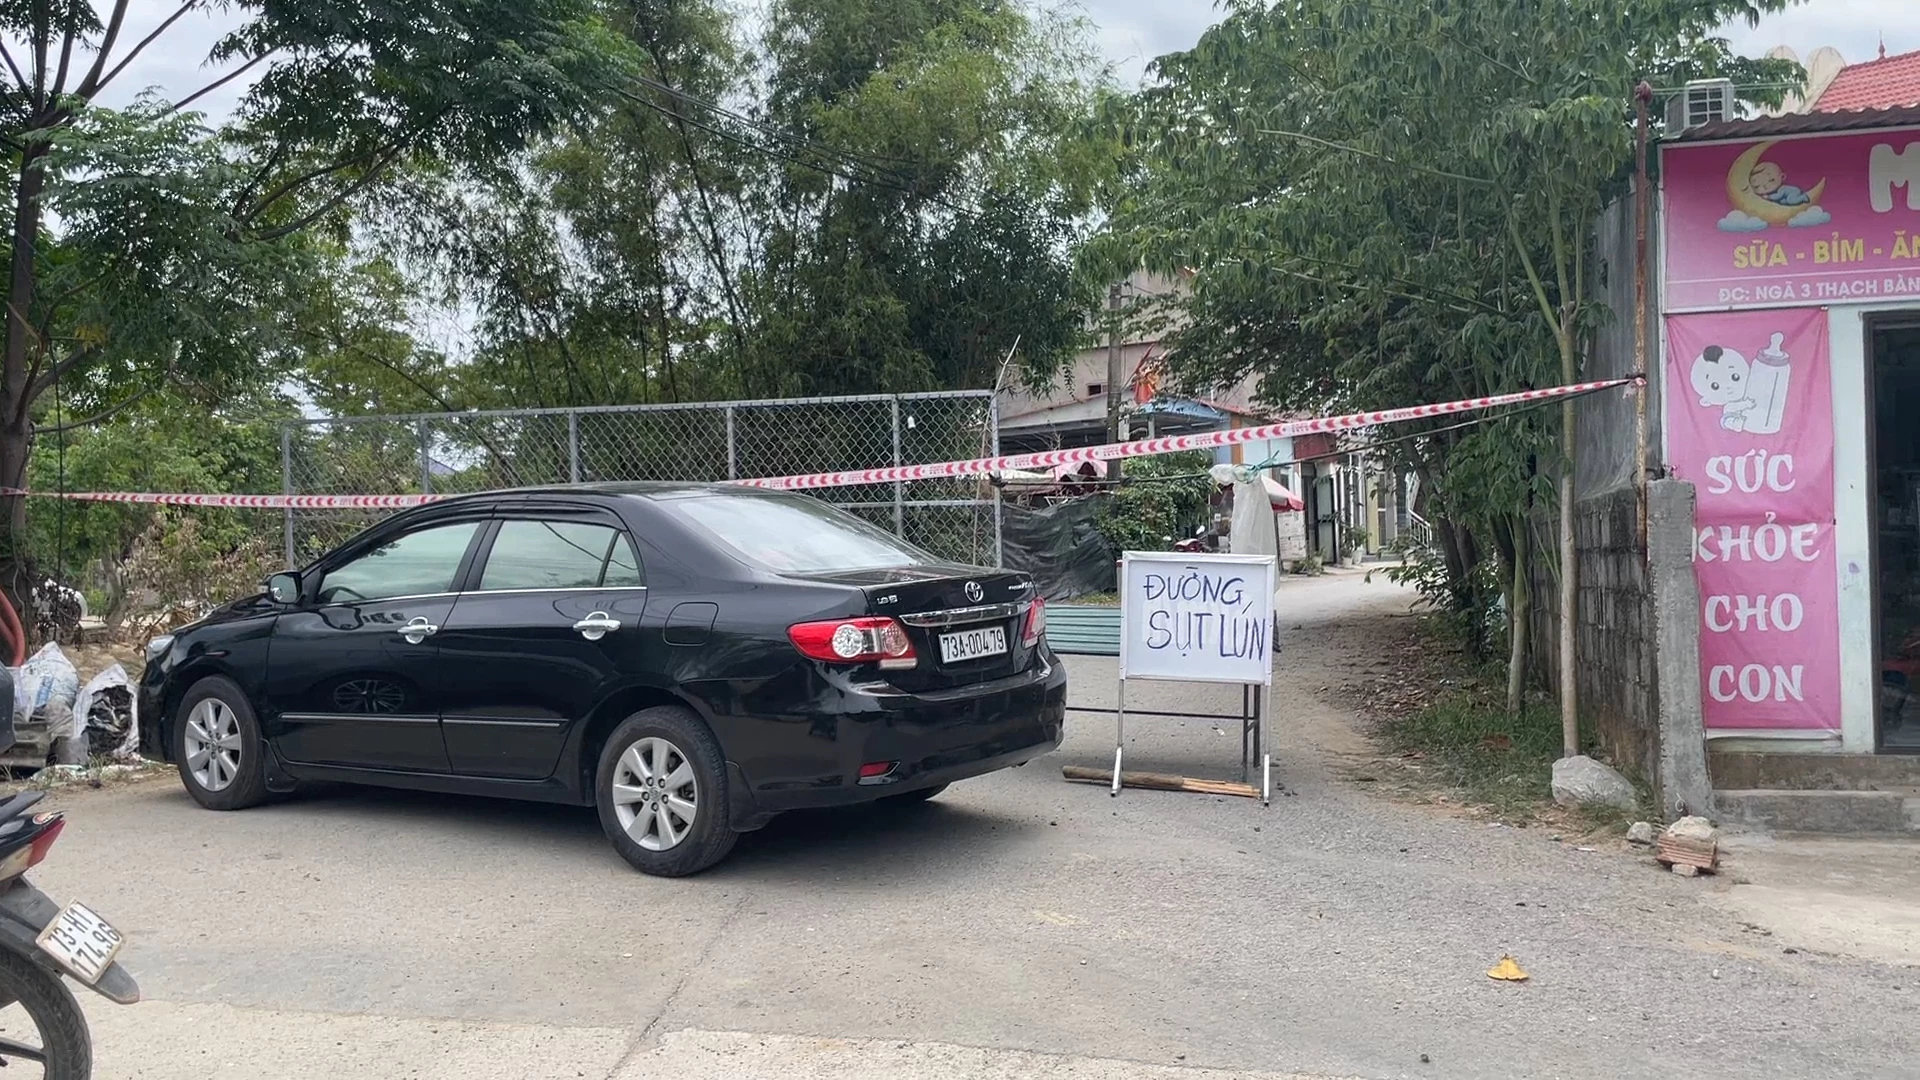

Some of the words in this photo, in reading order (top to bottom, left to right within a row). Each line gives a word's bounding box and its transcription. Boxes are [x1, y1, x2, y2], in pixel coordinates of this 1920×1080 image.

[1733, 239, 1789, 269] SỮA
[1813, 231, 1864, 264] BỈM
[1719, 287, 1750, 301] ĐC:
[1755, 280, 1796, 300] NGÃ
[1801, 283, 1811, 298] 3
[1816, 279, 1878, 299] THẠCH
[1705, 448, 1796, 494] SỨC
[1692, 511, 1820, 562] KHỎE
[1146, 610, 1213, 657] SỤT
[1219, 600, 1266, 661] LÚN
[1704, 593, 1803, 632] CHO
[942, 629, 1004, 661] 73A-004.79
[1709, 664, 1804, 702] CON
[70, 922, 121, 977] 174.96
